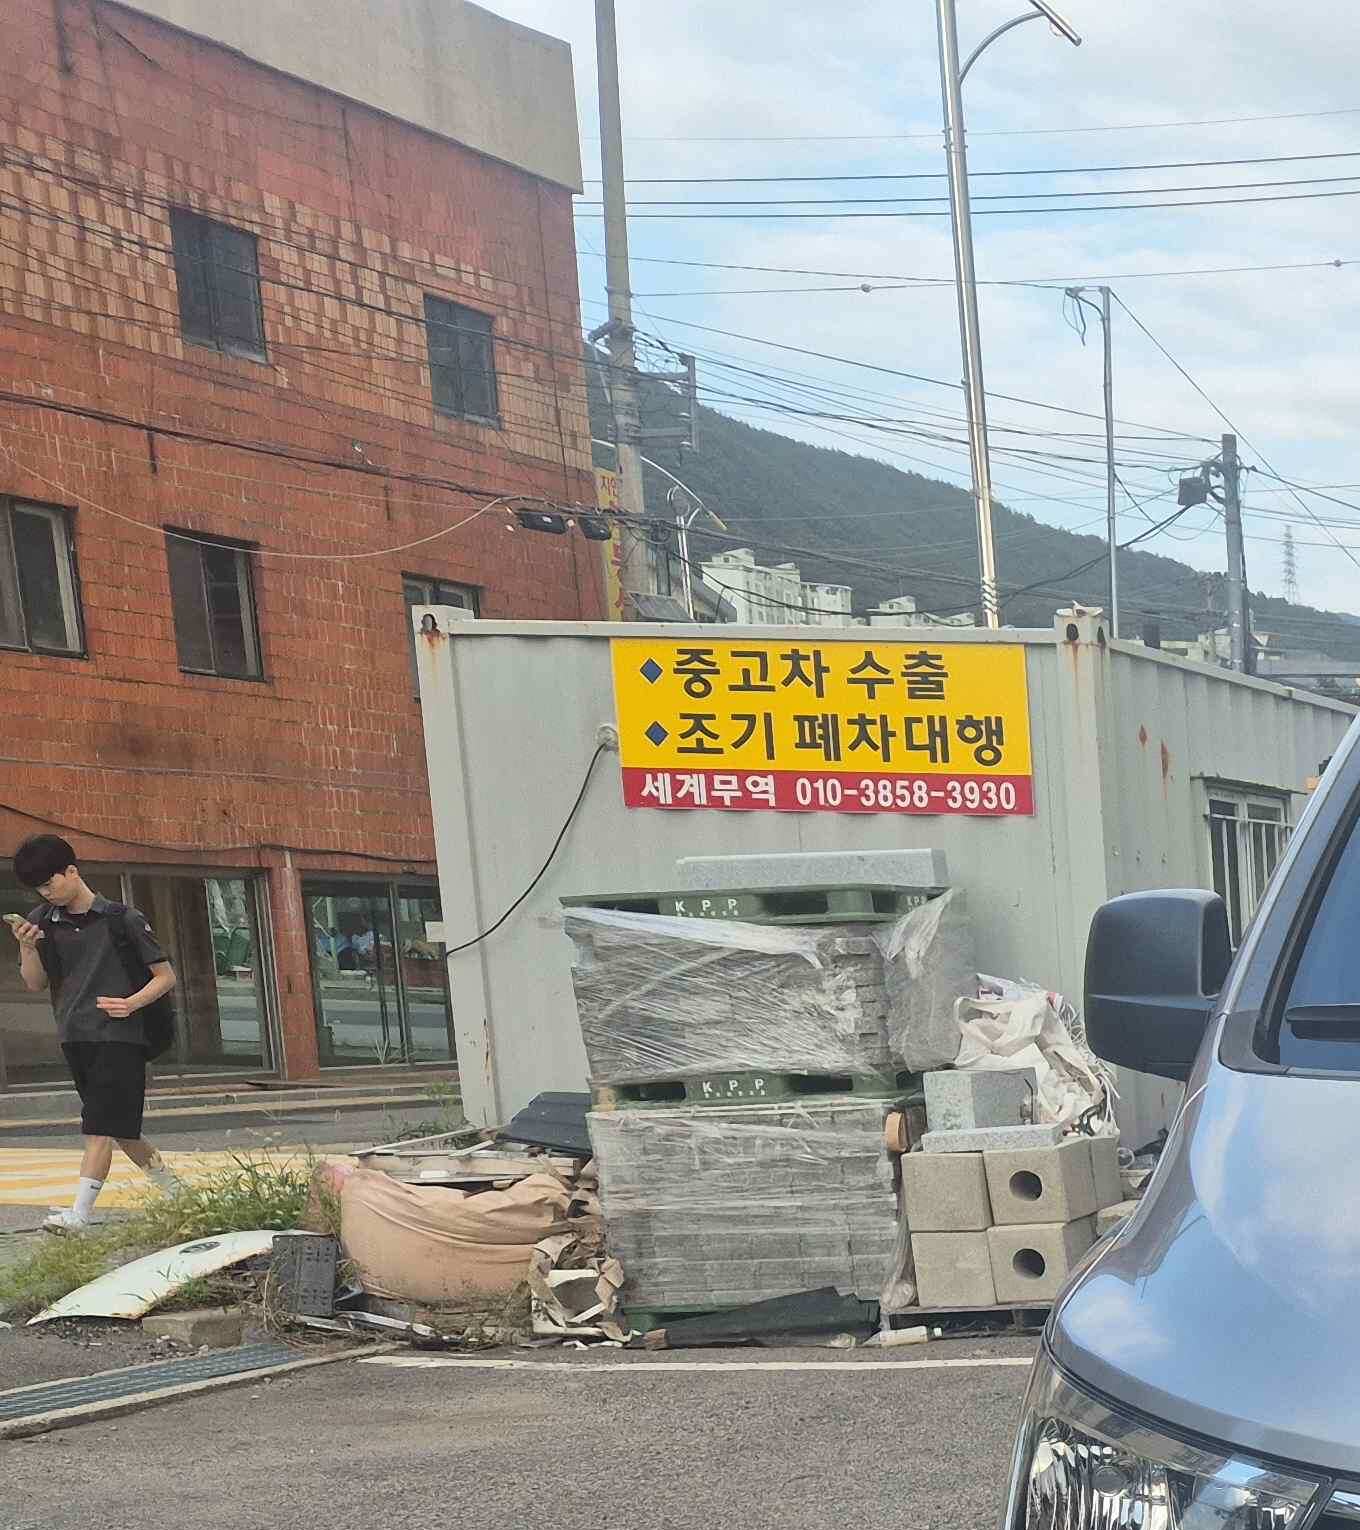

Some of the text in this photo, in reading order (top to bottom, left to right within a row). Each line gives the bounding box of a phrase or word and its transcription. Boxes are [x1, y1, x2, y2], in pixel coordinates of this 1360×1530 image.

[673, 648, 950, 701] 중고차 수출
[676, 711, 1005, 767] 조기 폐차대행
[640, 773, 1017, 811] 세계무역 010-3858-3930
